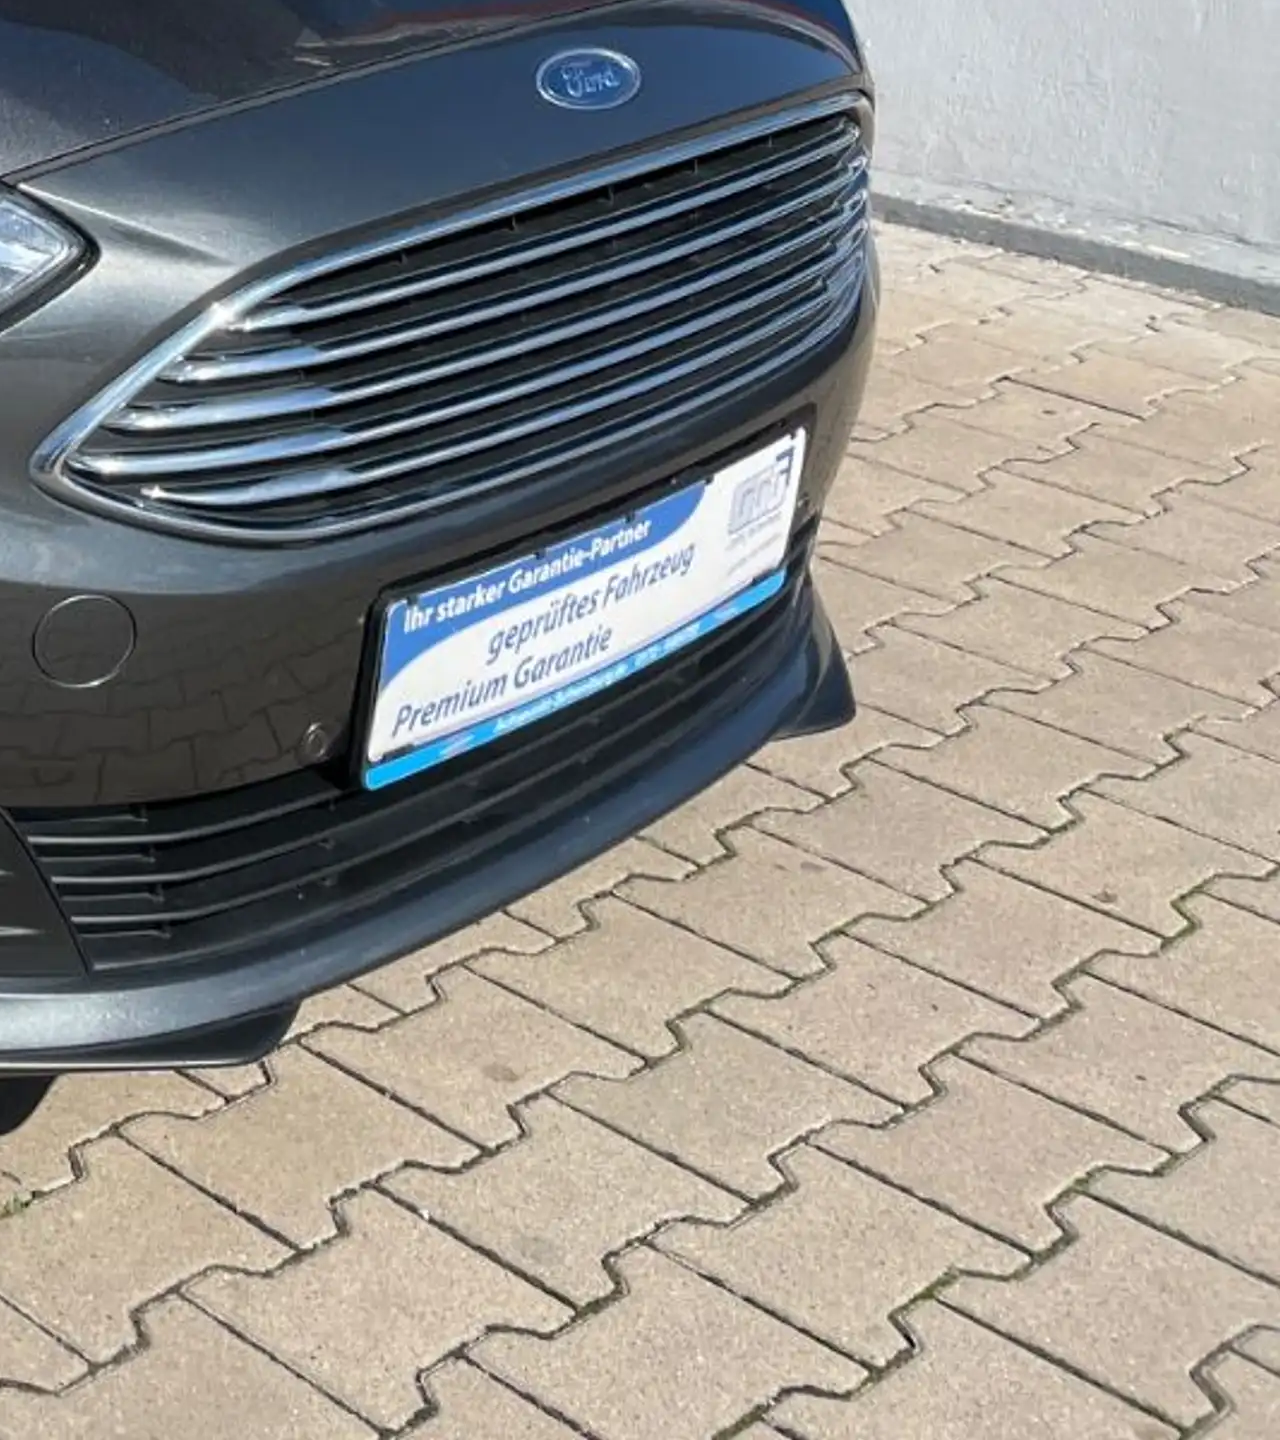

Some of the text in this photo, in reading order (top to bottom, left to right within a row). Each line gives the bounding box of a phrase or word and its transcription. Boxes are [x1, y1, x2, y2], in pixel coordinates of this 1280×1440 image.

[403, 520, 652, 634] Ihr starker Garantie-Partner
[486, 590, 602, 666] geprüftes
[600, 543, 697, 609] Fahrzeug
[391, 674, 508, 737] Premium
[513, 624, 613, 689] Garantie
